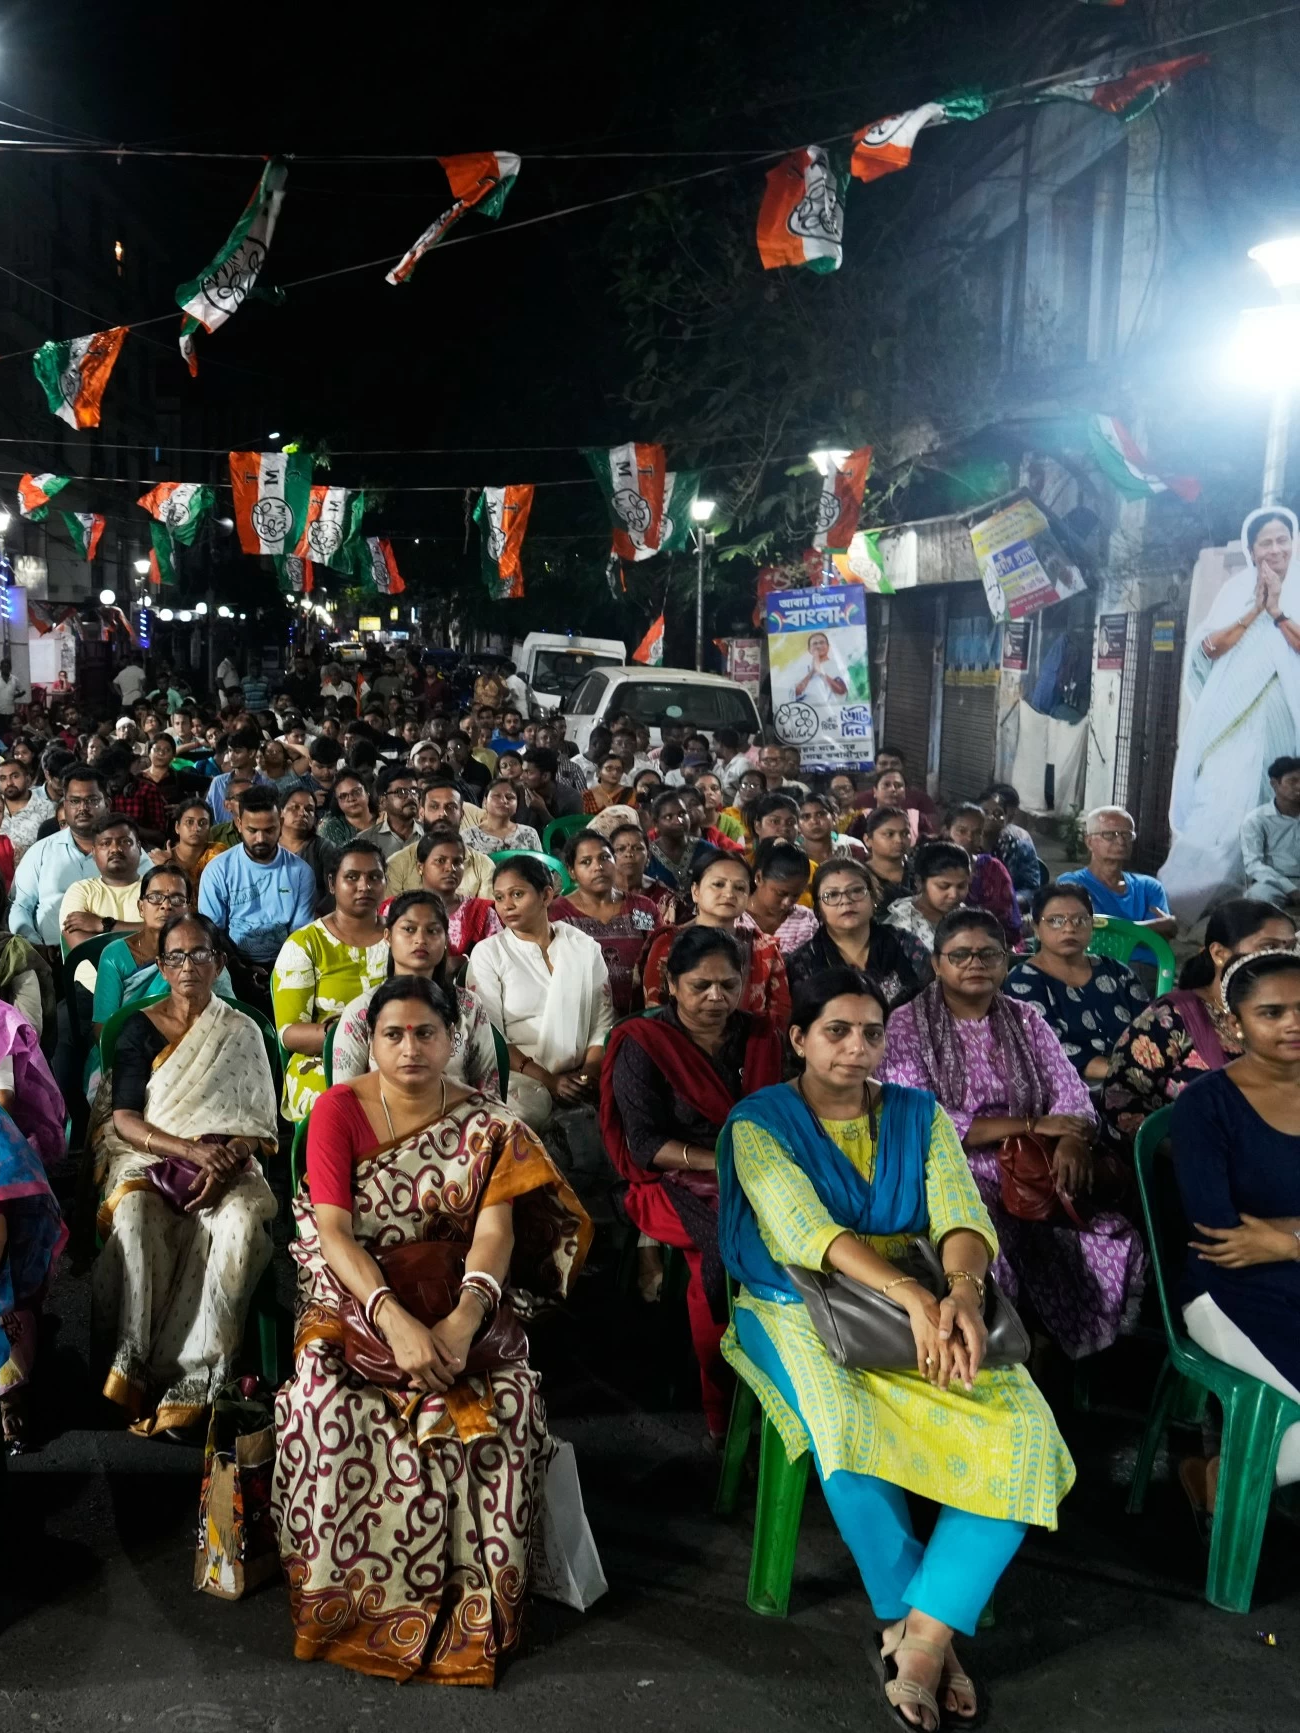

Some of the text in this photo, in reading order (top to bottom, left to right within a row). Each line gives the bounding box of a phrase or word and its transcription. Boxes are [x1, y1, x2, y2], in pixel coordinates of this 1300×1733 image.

[779, 592, 846, 609] আবার জিতবে
[783, 606, 844, 627] বাংলা
[841, 722, 866, 737] দিন
